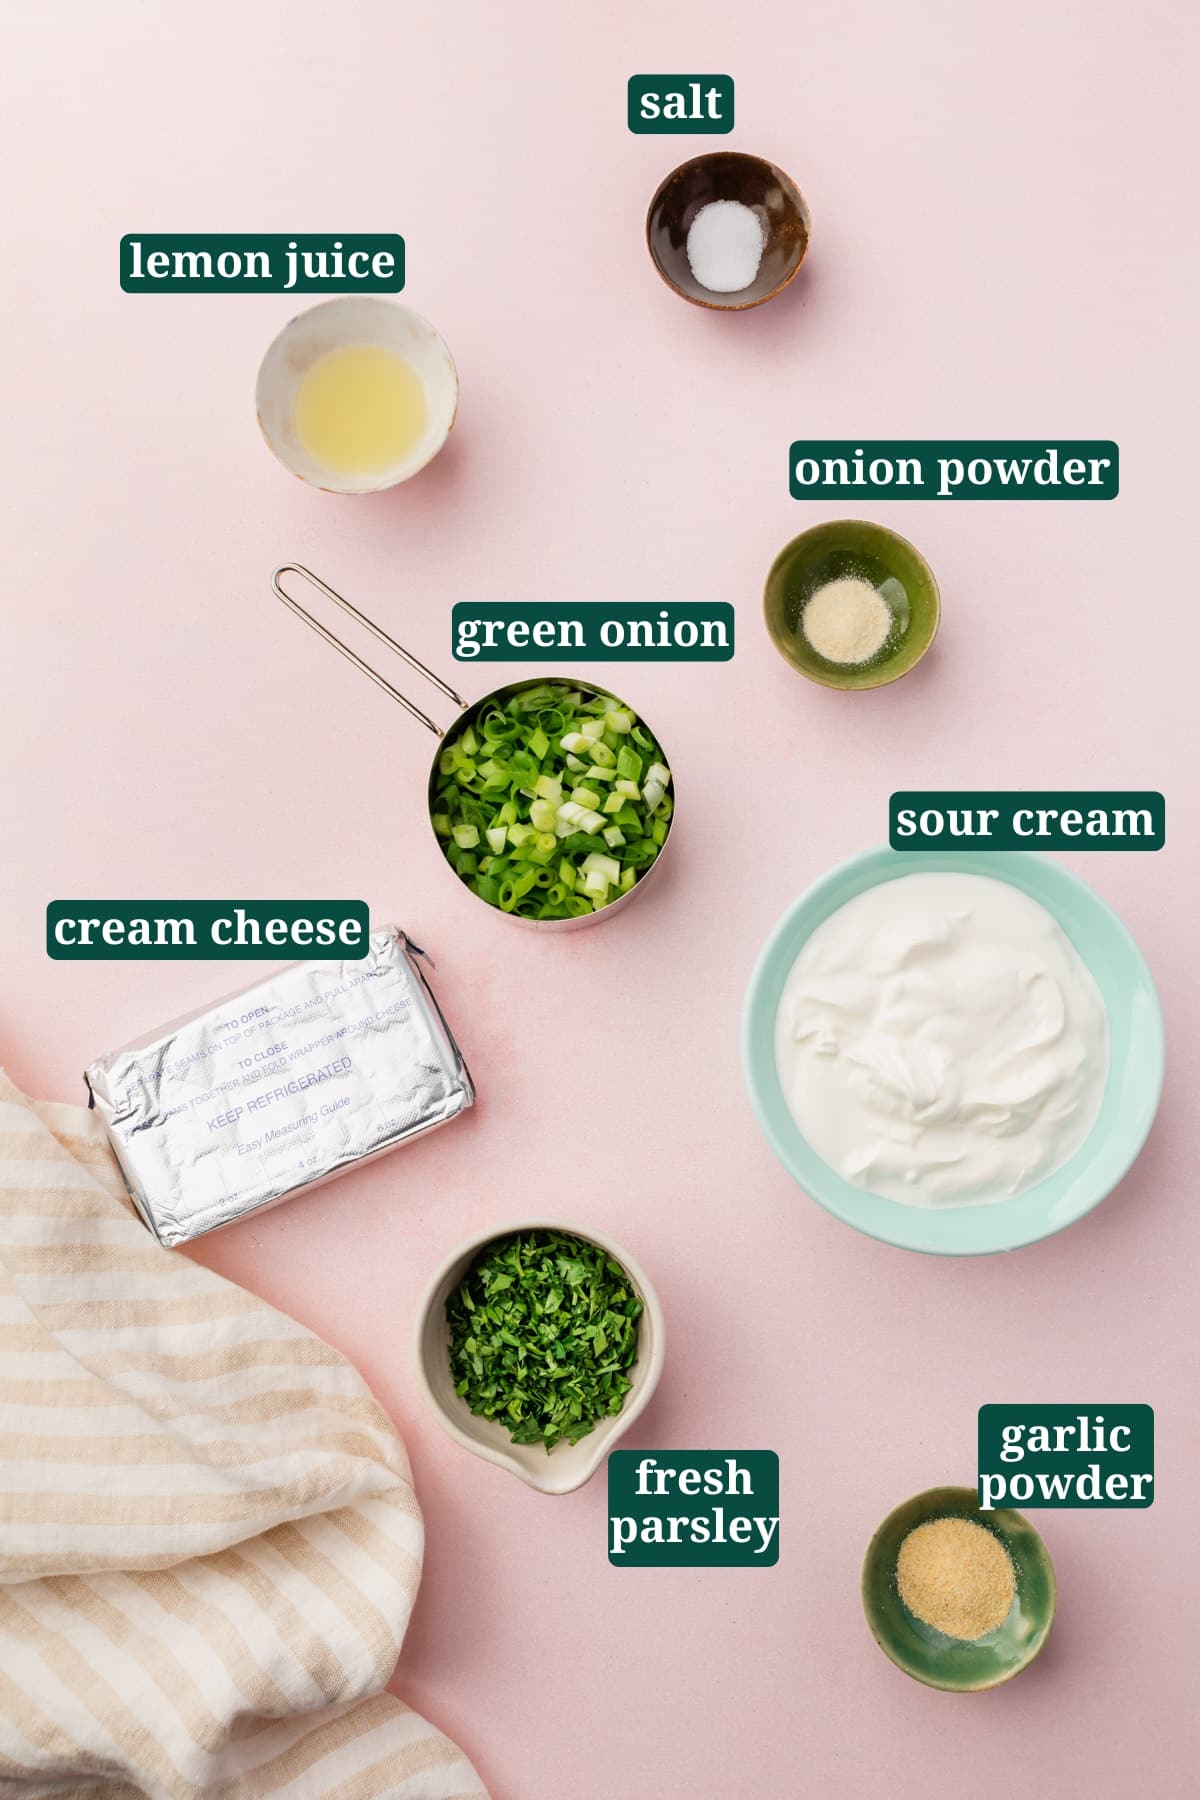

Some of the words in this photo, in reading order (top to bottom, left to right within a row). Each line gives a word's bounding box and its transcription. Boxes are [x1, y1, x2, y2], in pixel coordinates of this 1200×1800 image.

[174, 1049, 207, 1071] SEAMS
[207, 1043, 223, 1055] ON
[224, 1032, 242, 1046] TOP
[243, 1025, 257, 1038] OF
[258, 1005, 303, 1029] PACKAGE
[304, 995, 324, 1009] AND
[324, 984, 350, 999] PULL
[224, 1019, 239, 1031] TO
[240, 1005, 270, 1023] OPEN
[190, 1079, 241, 1105] TOGETHER
[241, 1069, 261, 1083] AND
[262, 1056, 287, 1075] FOLD
[288, 1034, 334, 1060] WRAPPER
[336, 1016, 374, 1039] AROUND
[375, 998, 411, 1021] CHEESE
[238, 1058, 252, 1069] TO
[254, 1041, 289, 1062] CLOSE
[207, 1106, 243, 1132] KEEP
[246, 1056, 352, 1112] REFRIGERATED
[237, 1137, 263, 1156] Easy
[265, 1111, 319, 1144] Measuring
[320, 1096, 351, 1117] Guide
[298, 1160, 305, 1169] 4
